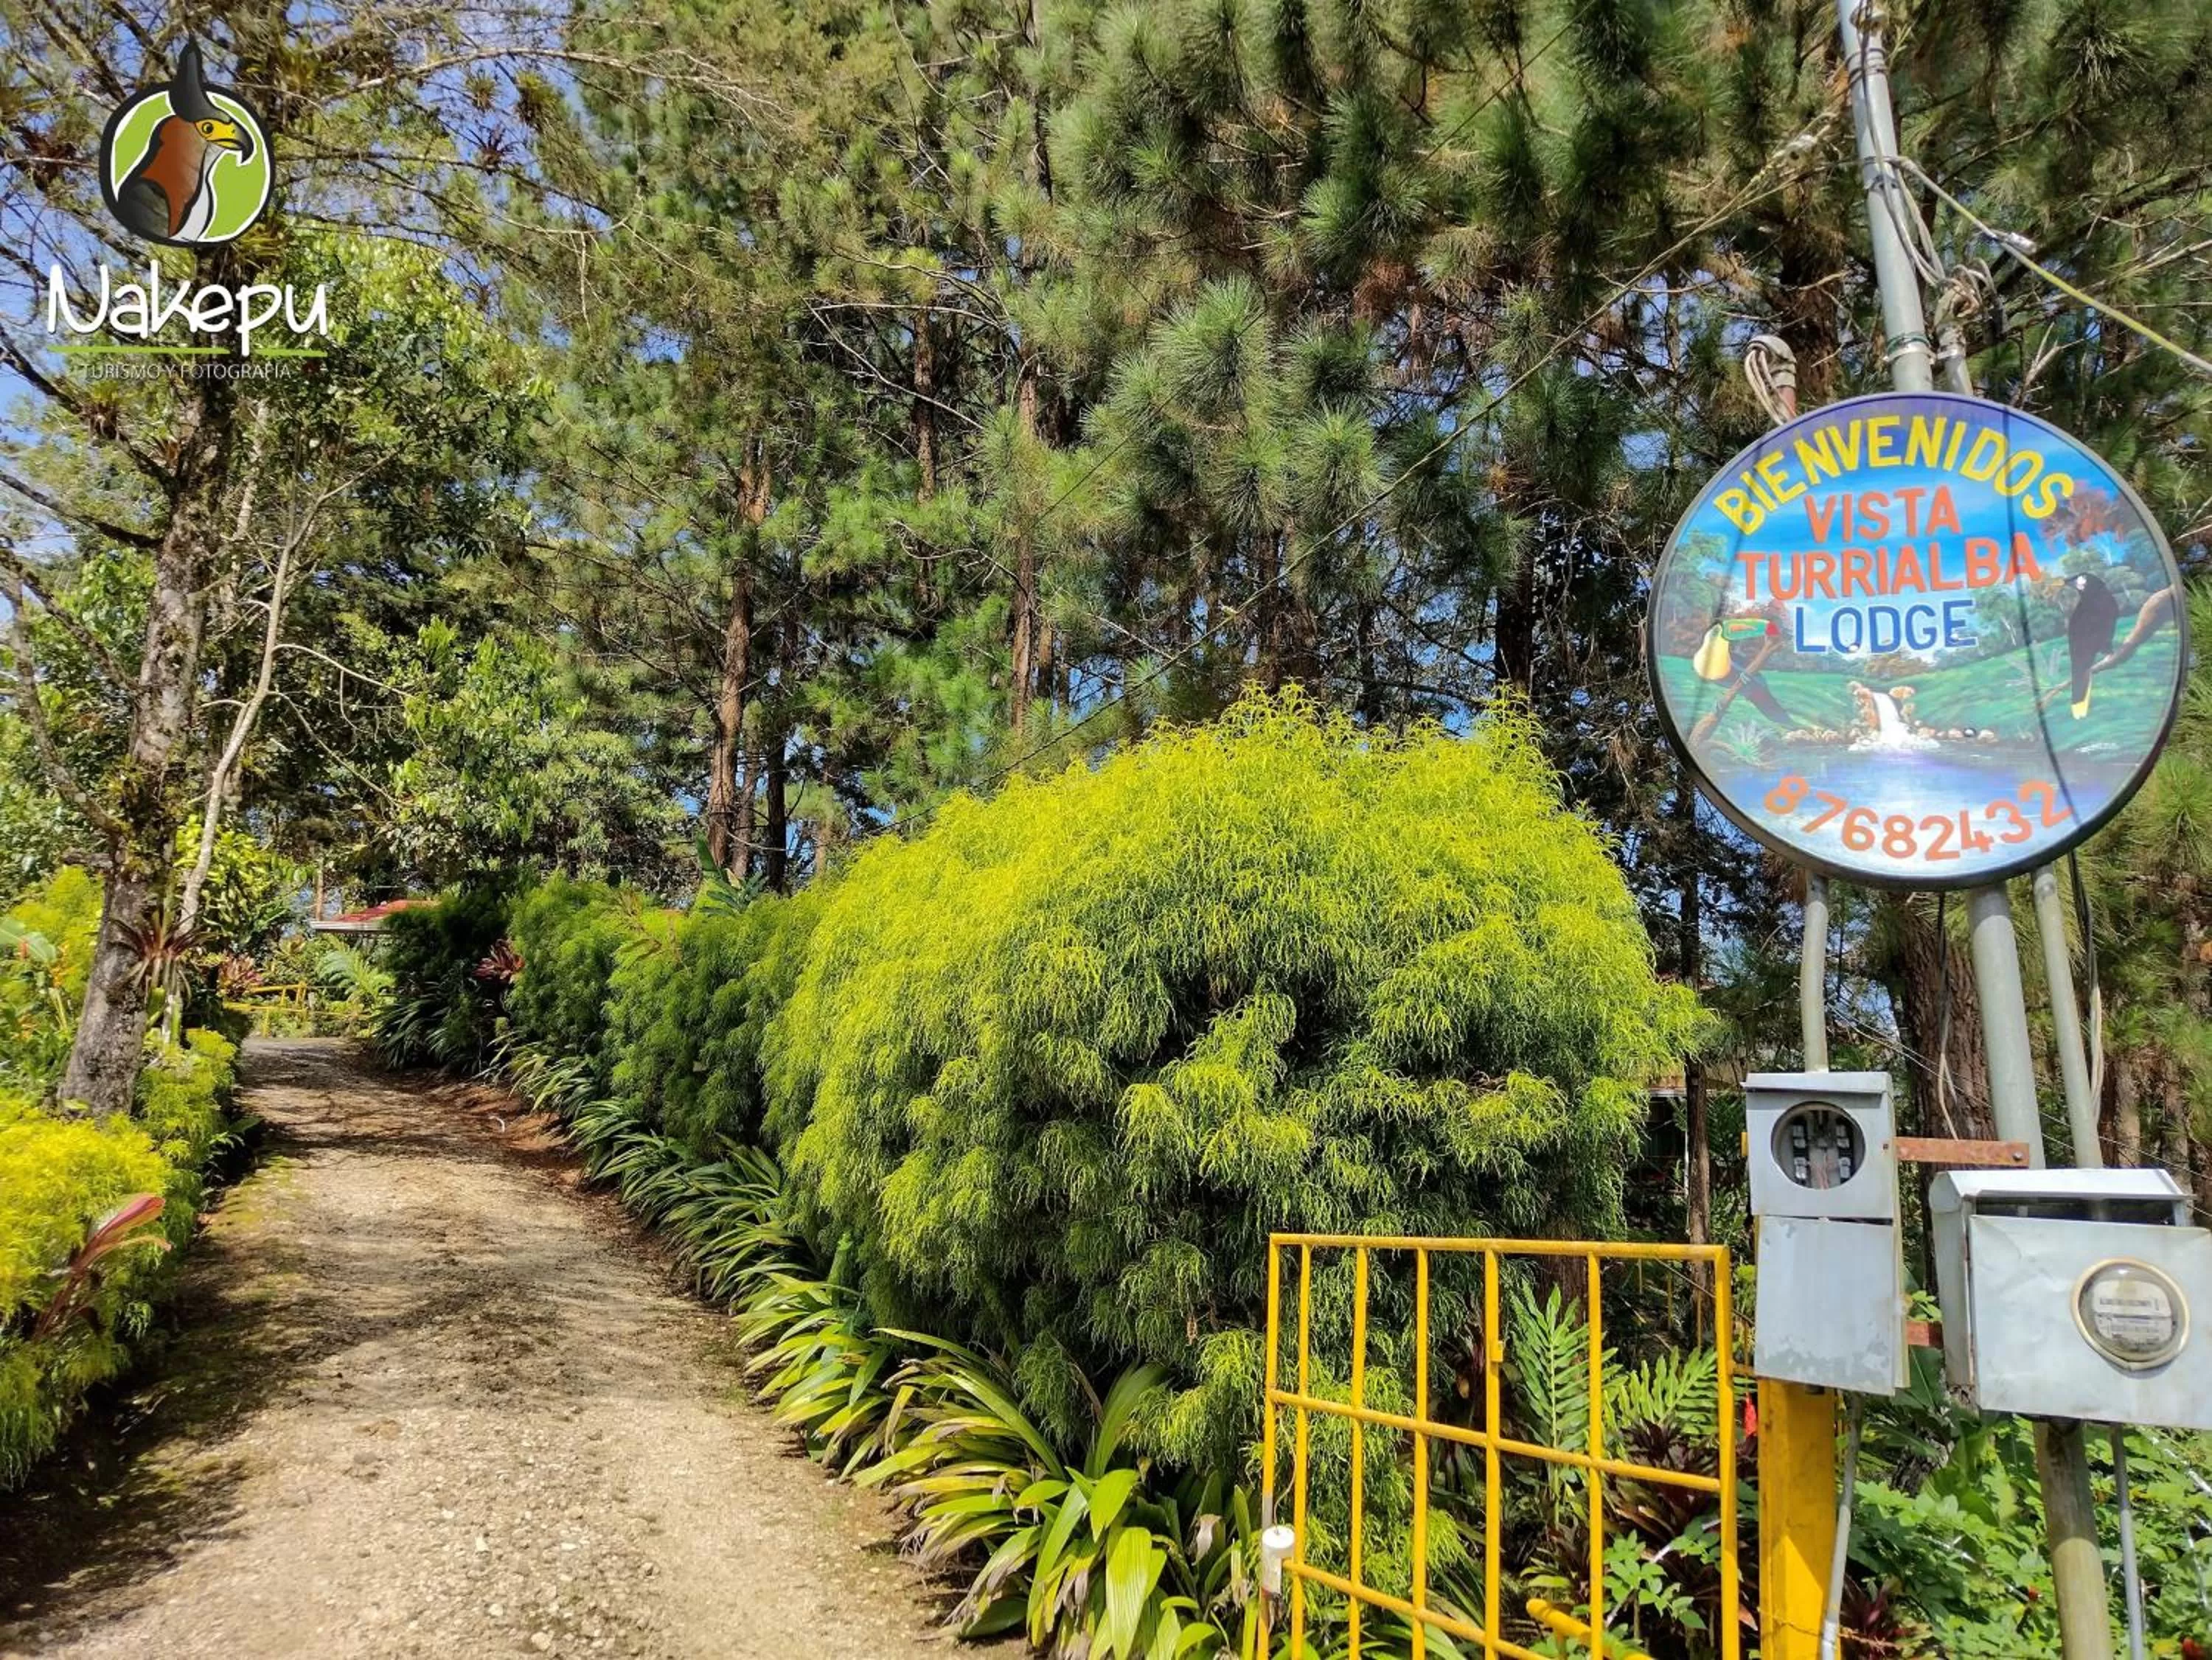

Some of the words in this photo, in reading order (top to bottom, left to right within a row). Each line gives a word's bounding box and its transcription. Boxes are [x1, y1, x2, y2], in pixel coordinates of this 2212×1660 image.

[1713, 414, 2074, 535] BIENVENIDOS
[1804, 484, 1961, 544] VISTA
[1735, 531, 2046, 602] TURRIALBA
[1793, 599, 1979, 655] LODGE
[1763, 774, 2073, 862] 87682432
